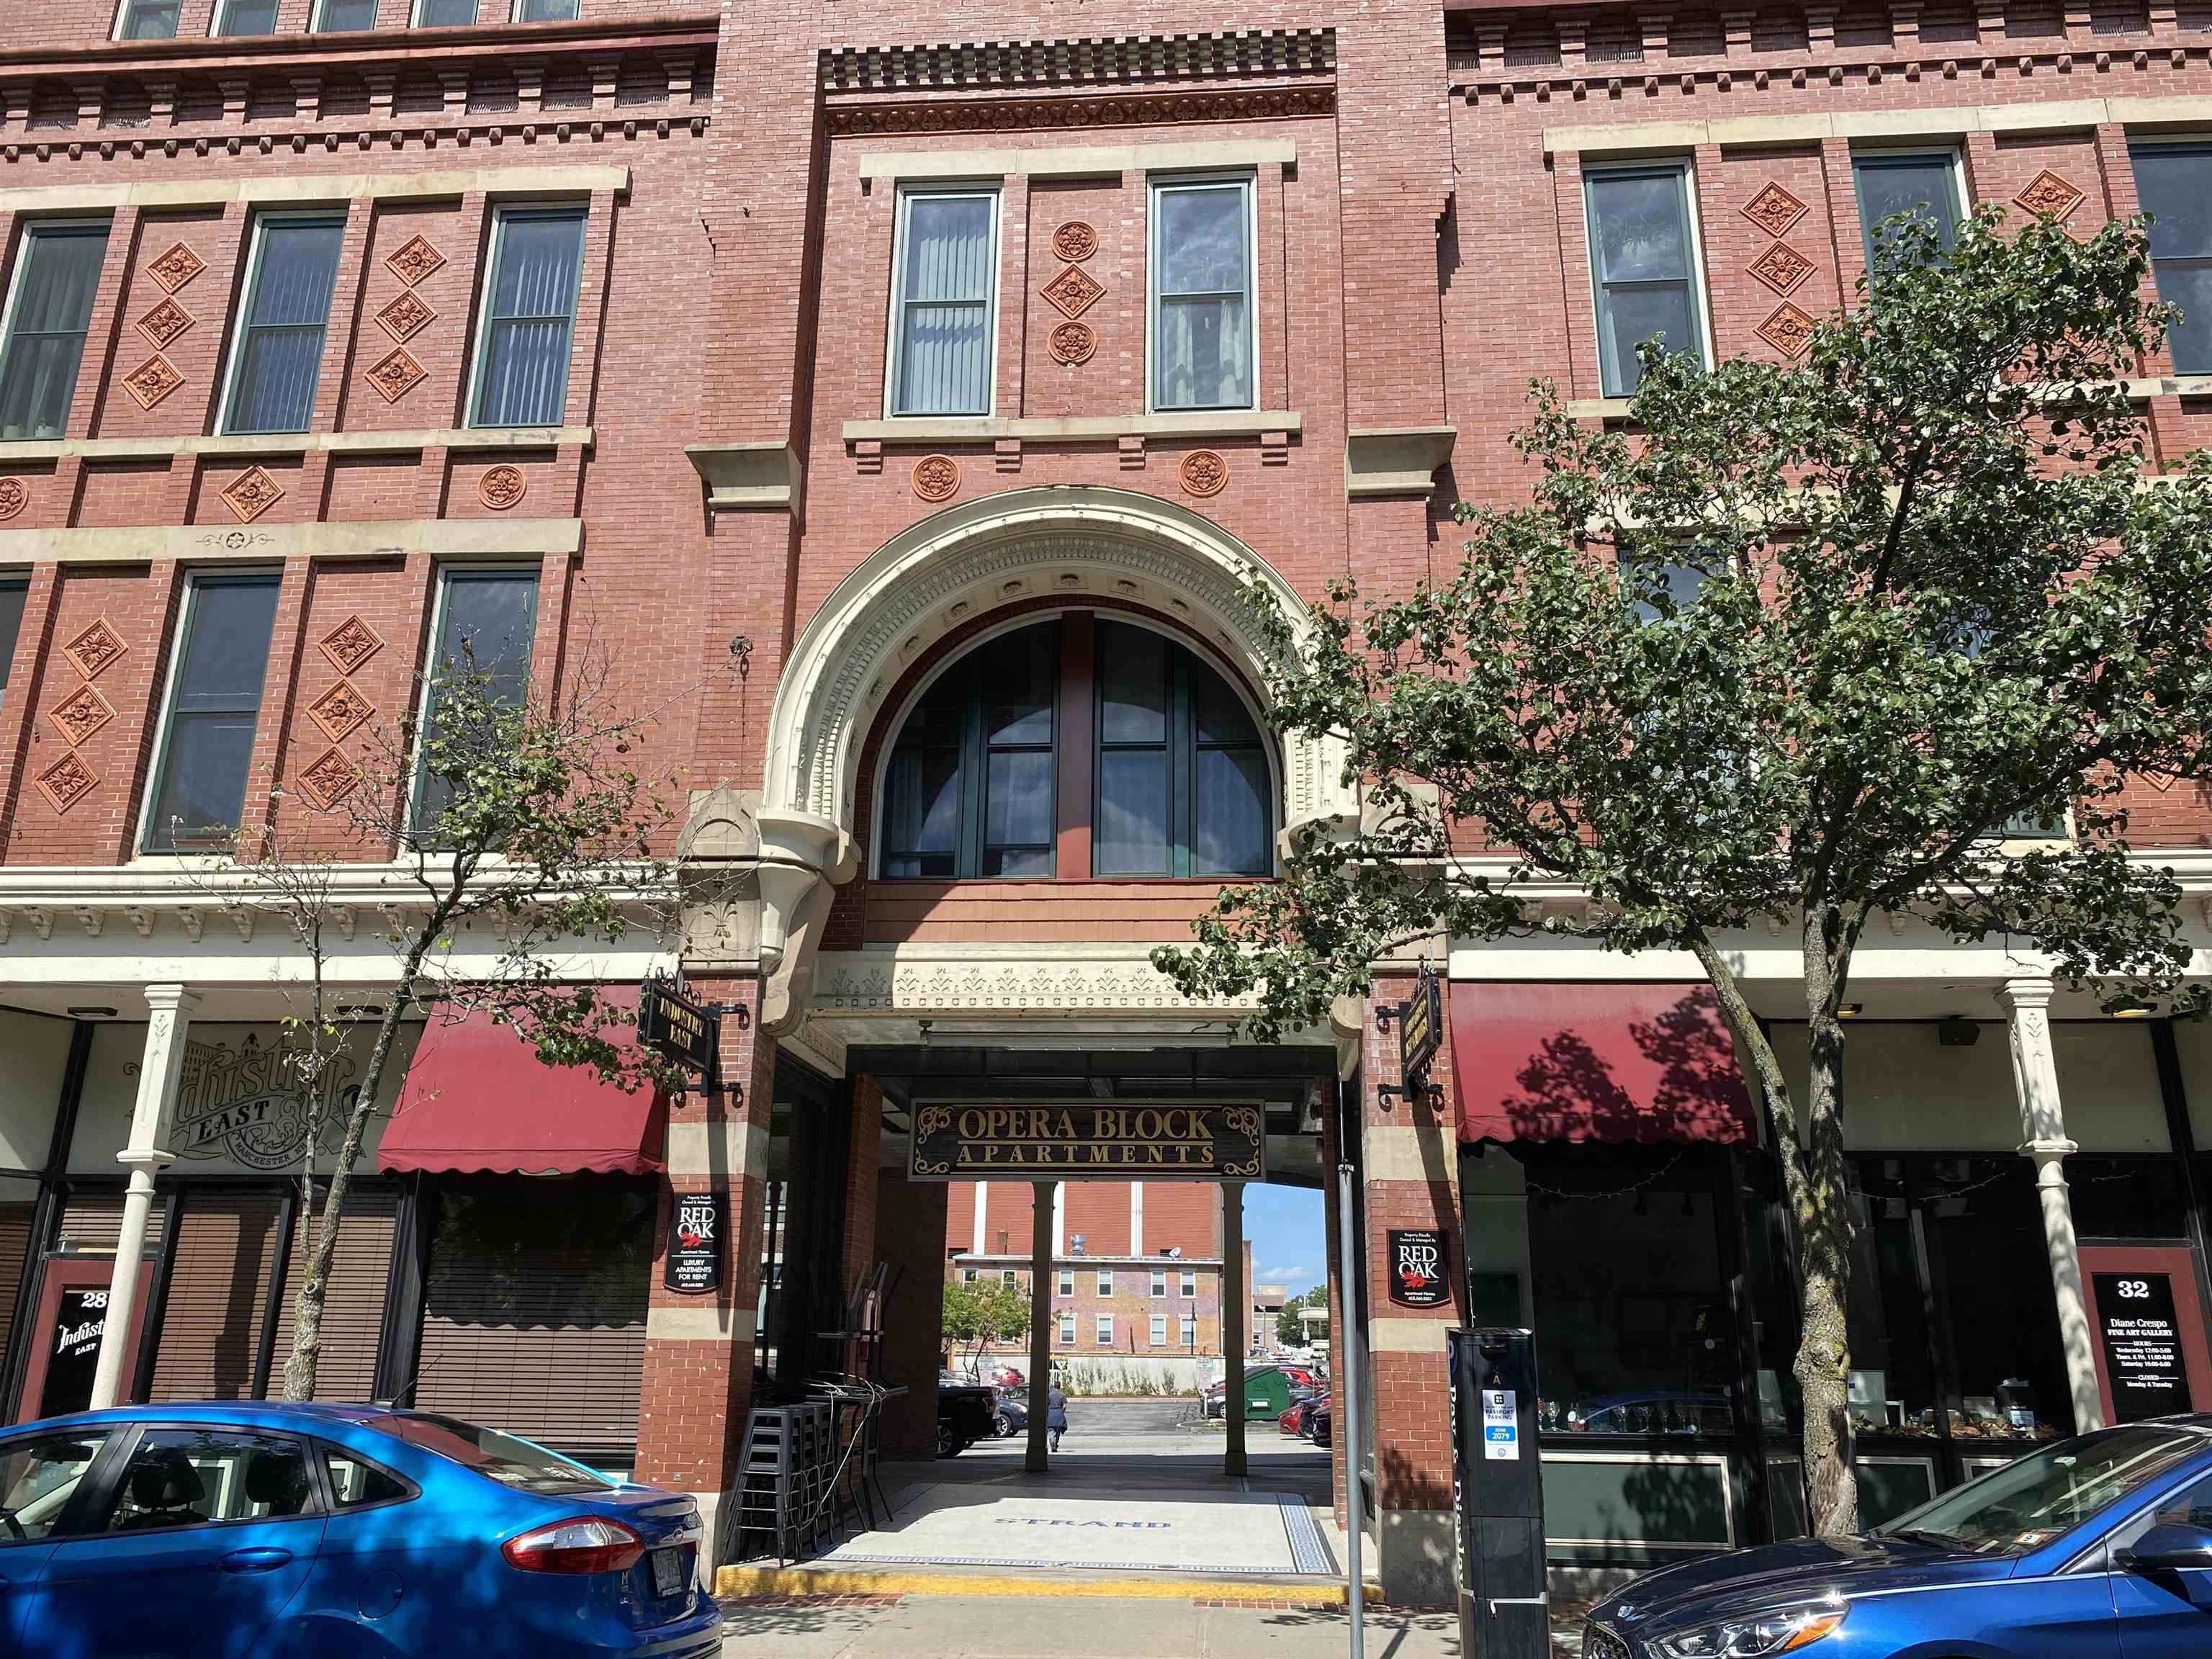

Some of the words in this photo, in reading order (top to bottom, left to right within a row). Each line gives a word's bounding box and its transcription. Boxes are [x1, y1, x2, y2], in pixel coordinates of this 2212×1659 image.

[659, 997, 704, 1038] INDUSTRY
[669, 1024, 693, 1051] EAST
[197, 1100, 270, 1143] EAST
[958, 1109, 1078, 1140] OPERA
[1092, 1109, 1215, 1140] BLOCK
[235, 1142, 290, 1165] MANCHESTER
[956, 1145, 1215, 1164] APARTMENTS
[680, 1207, 716, 1225] RED
[677, 1223, 715, 1238] OAK
[1398, 1245, 1437, 1264] RED
[1398, 1262, 1440, 1279] OAK
[2118, 1281, 2149, 1298] 32
[81, 1292, 107, 1308] 28
[2110, 1318, 2136, 1328] Diane
[2136, 1318, 2167, 1329] Crespo
[57, 1319, 105, 1354] Indust
[74, 1343, 97, 1356] EAST
[993, 1517, 1172, 1527] STRAND
